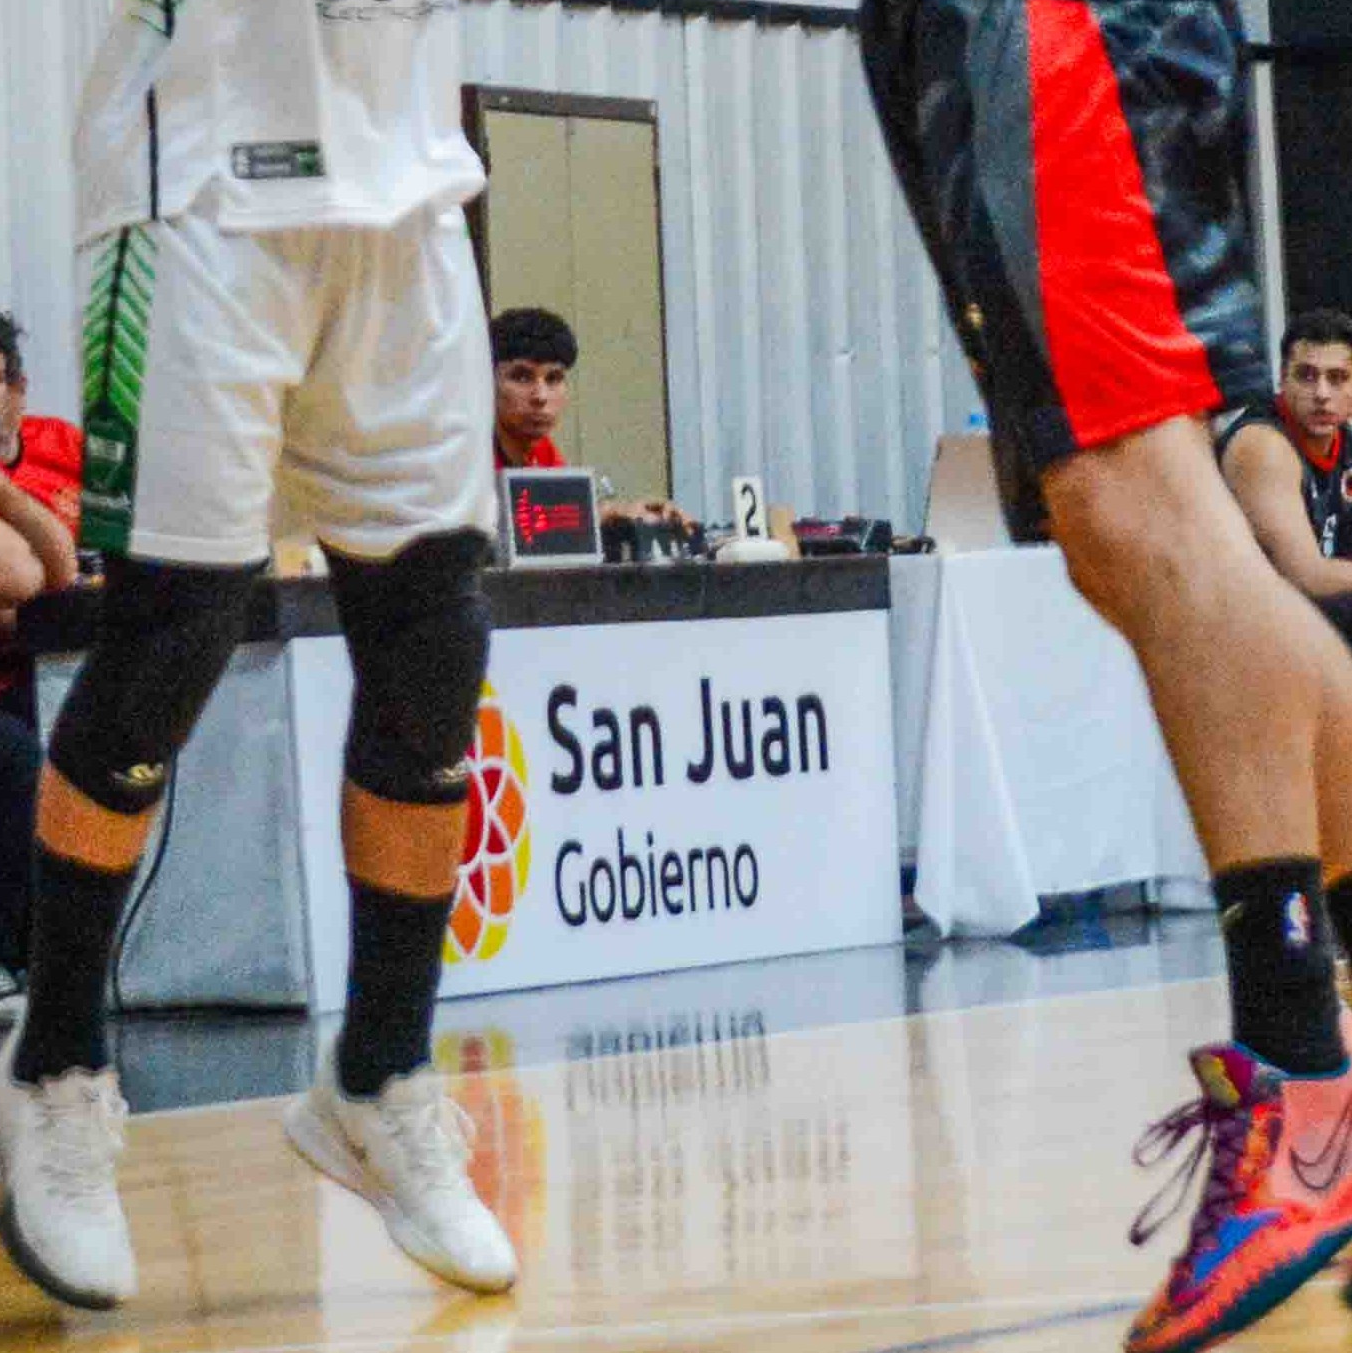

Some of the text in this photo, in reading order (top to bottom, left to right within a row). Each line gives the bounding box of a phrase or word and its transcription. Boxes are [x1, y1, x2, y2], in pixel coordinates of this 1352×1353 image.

[741, 483, 761, 536] 2
[547, 677, 829, 795] San Juan
[554, 826, 759, 927] Gobierno
